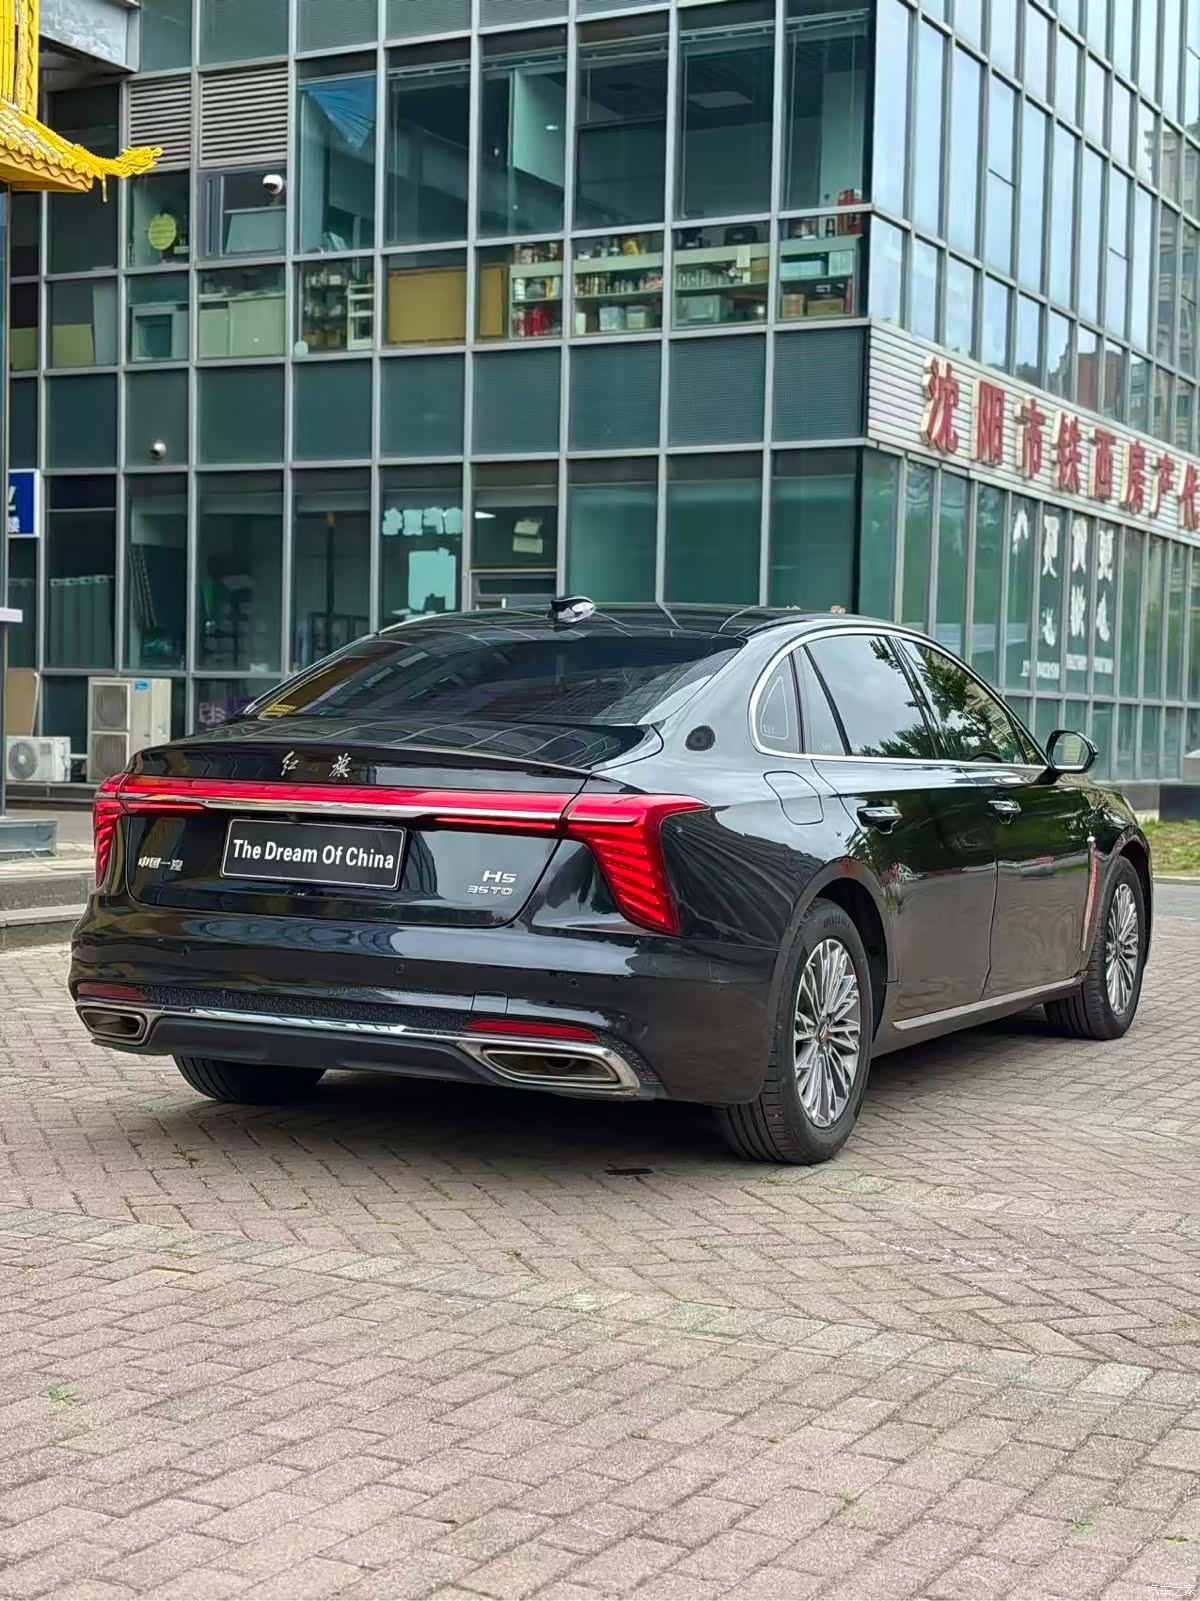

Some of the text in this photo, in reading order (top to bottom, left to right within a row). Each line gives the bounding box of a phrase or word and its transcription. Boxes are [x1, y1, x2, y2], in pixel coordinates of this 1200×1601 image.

[281, 750, 352, 780] 红旗
[233, 839, 394, 869] The Dream Of China
